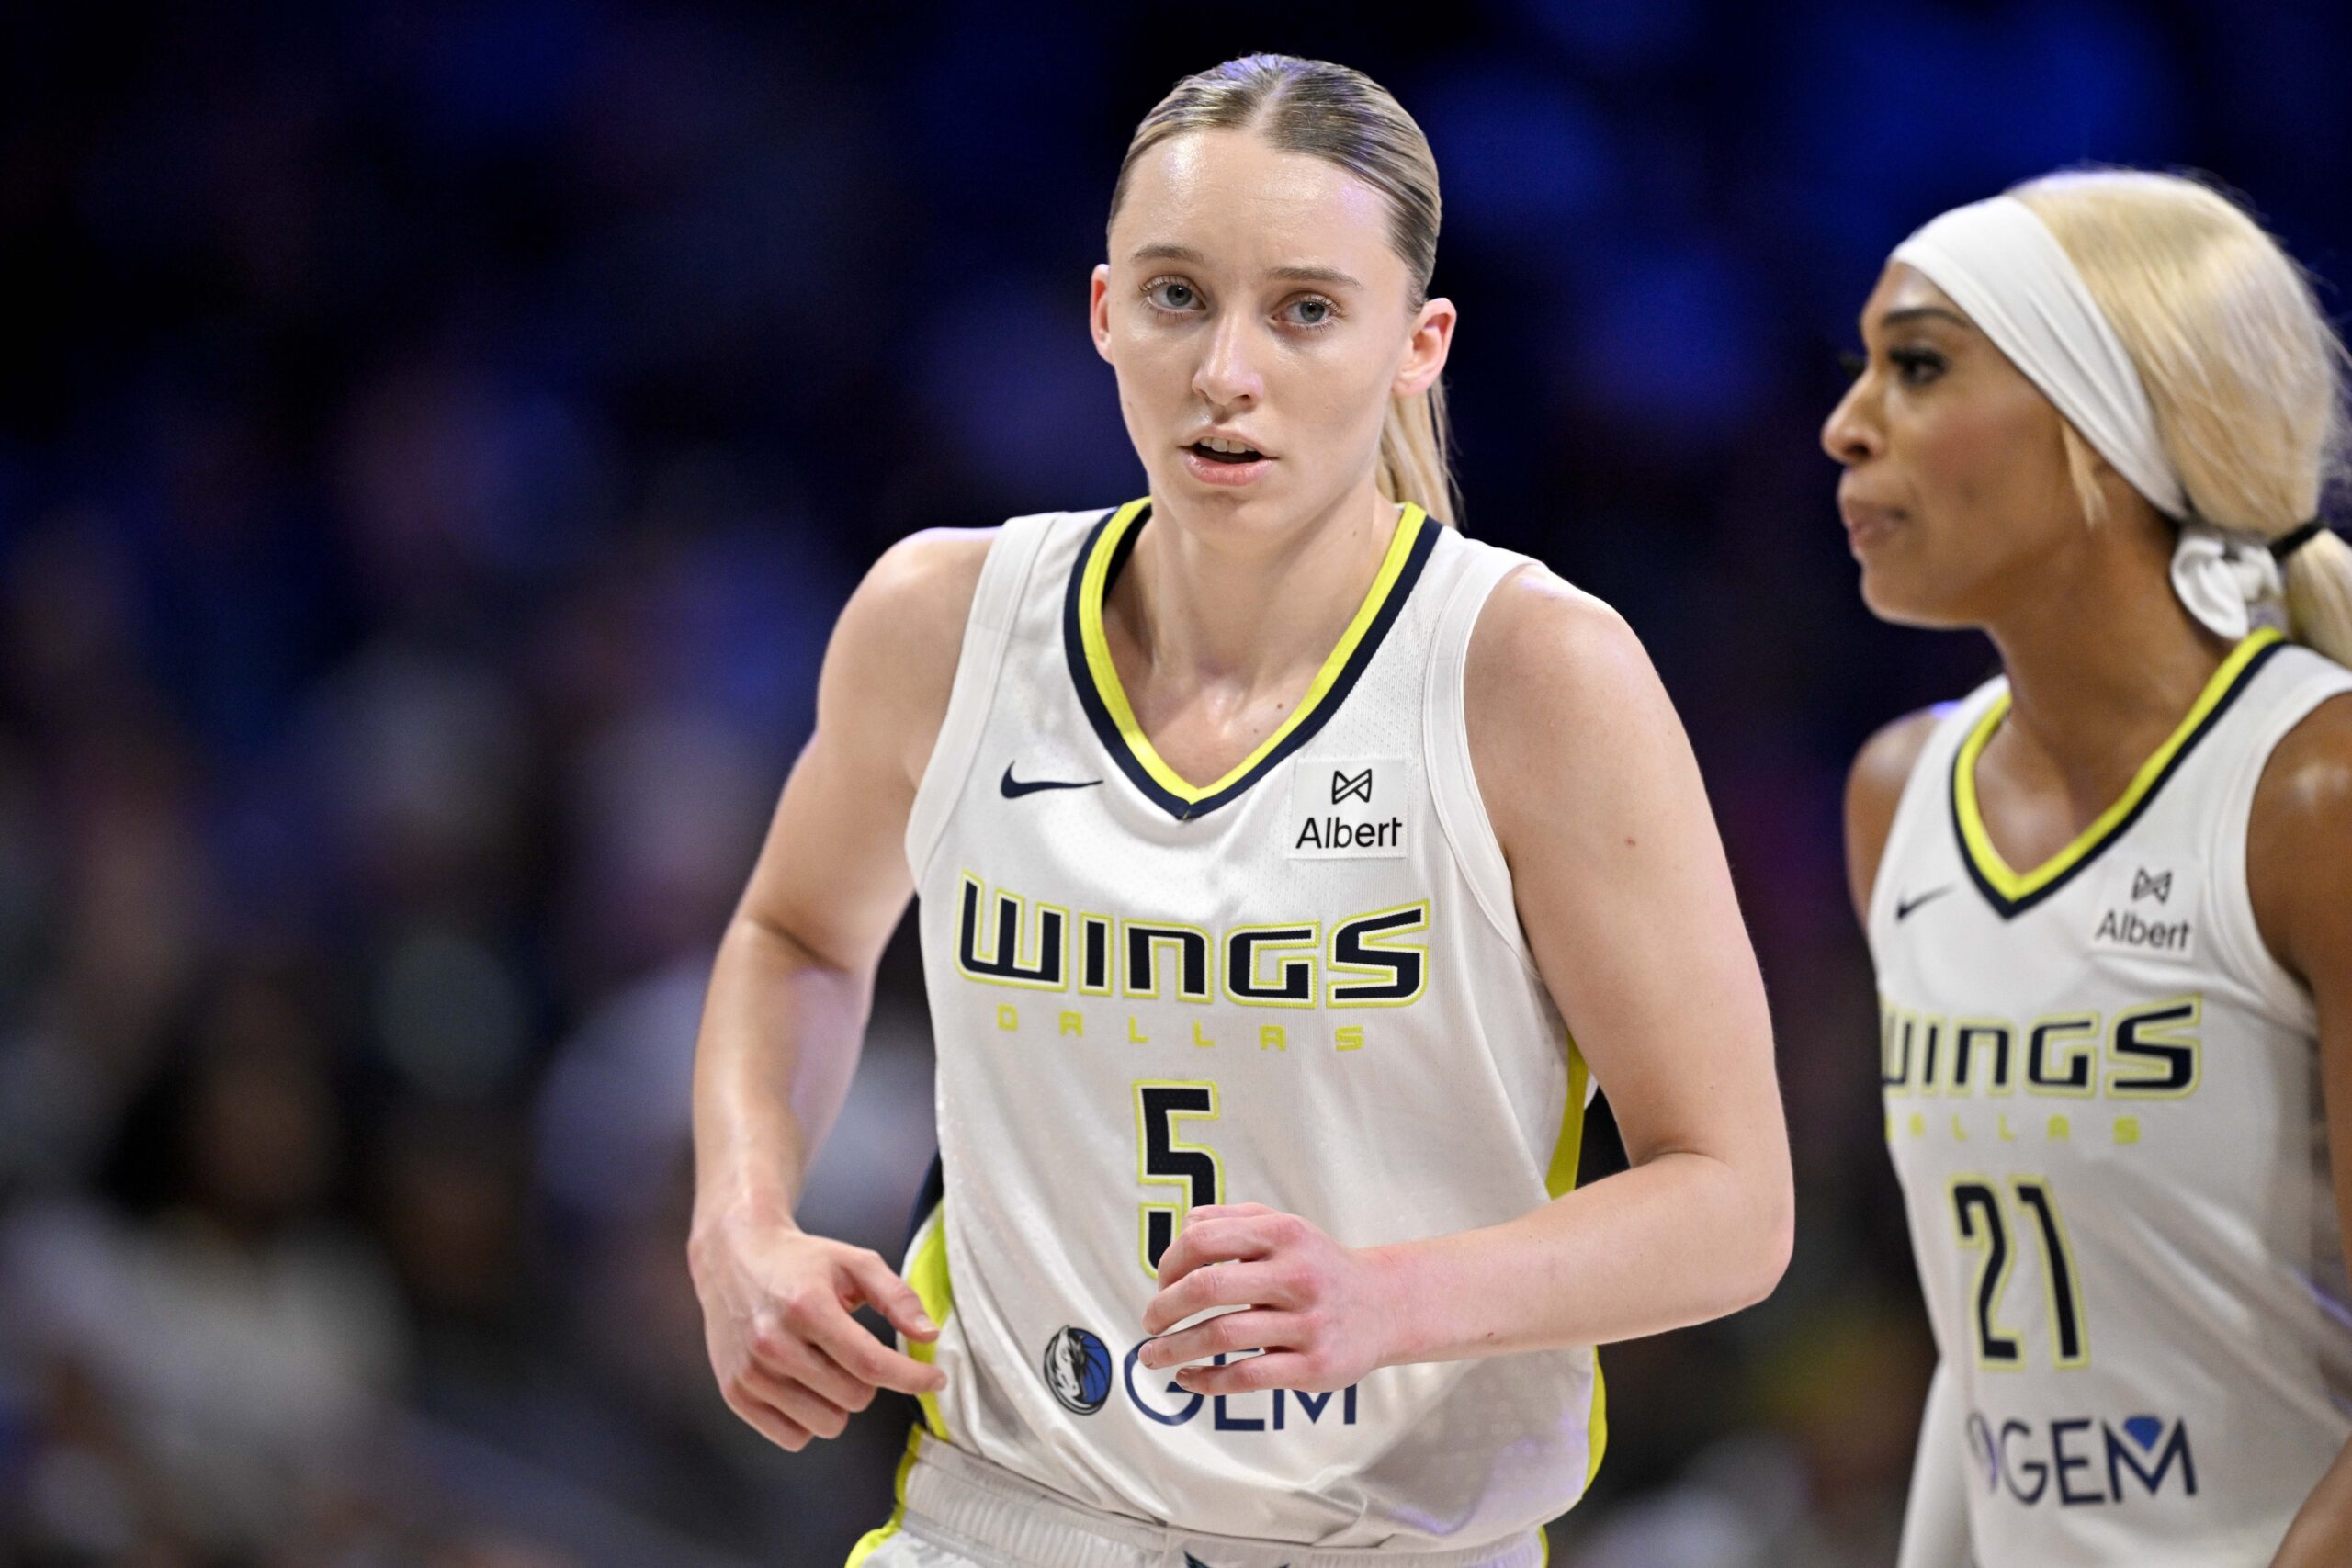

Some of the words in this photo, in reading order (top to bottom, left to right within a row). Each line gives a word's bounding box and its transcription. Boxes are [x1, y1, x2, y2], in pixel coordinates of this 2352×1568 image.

[1295, 817, 1403, 849] Albert
[955, 868, 1430, 1010] WINGS
[2095, 908, 2190, 951] Albert
[996, 1005, 1363, 1051] DALLAS
[1132, 1079, 1225, 1279] 5
[1947, 1174, 2090, 1371] 21
